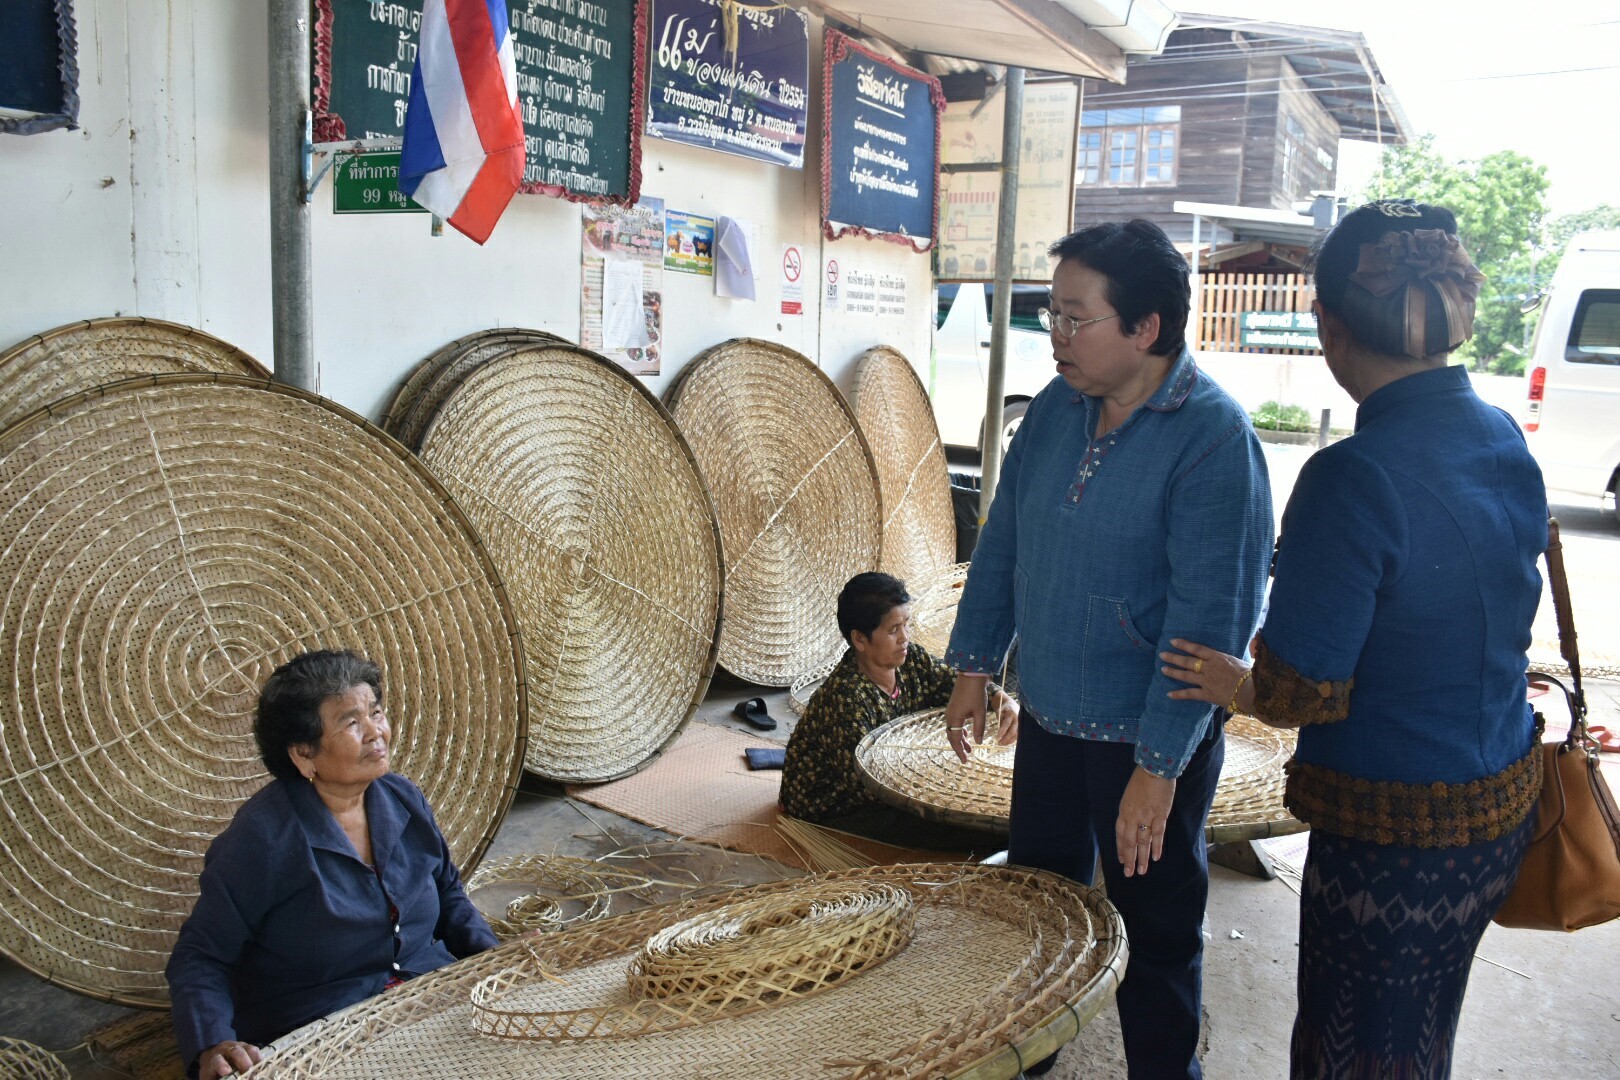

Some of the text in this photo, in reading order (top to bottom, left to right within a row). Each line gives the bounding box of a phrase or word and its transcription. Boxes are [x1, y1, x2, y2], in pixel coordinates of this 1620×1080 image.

[370, 1, 422, 32] ประกอบอ
[658, 13, 717, 71] แม่
[516, 66, 542, 102] าร์มหมู
[856, 65, 909, 109] วิสัยทัศน์
[746, 109, 754, 125] 2
[348, 158, 400, 179] ที่ทำการ
[363, 188, 380, 204] 99
